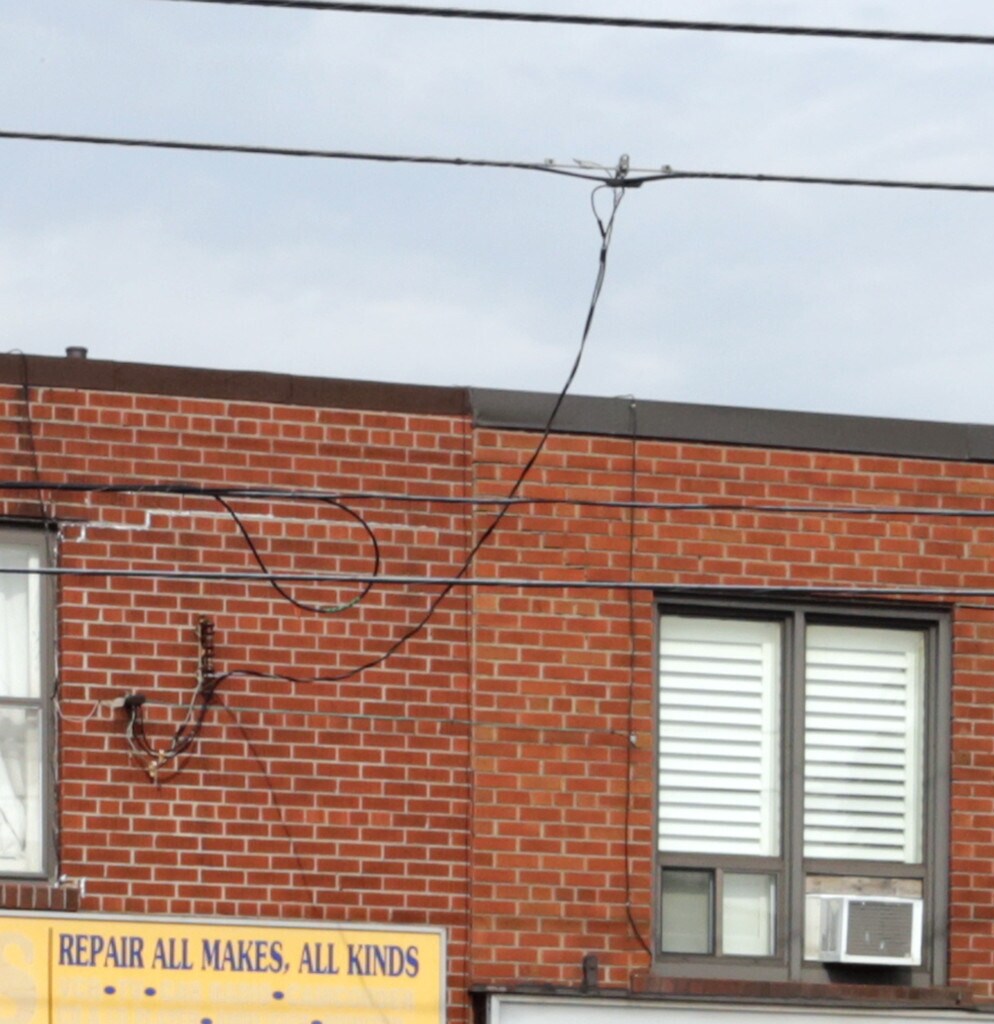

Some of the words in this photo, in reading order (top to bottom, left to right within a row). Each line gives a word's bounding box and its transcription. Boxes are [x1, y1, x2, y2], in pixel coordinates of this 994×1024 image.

[58, 933, 145, 969] REPAIR
[151, 938, 193, 970] ALL
[202, 939, 290, 975] MAKES,
[299, 942, 340, 975] ALL
[347, 944, 419, 978] KINDS
